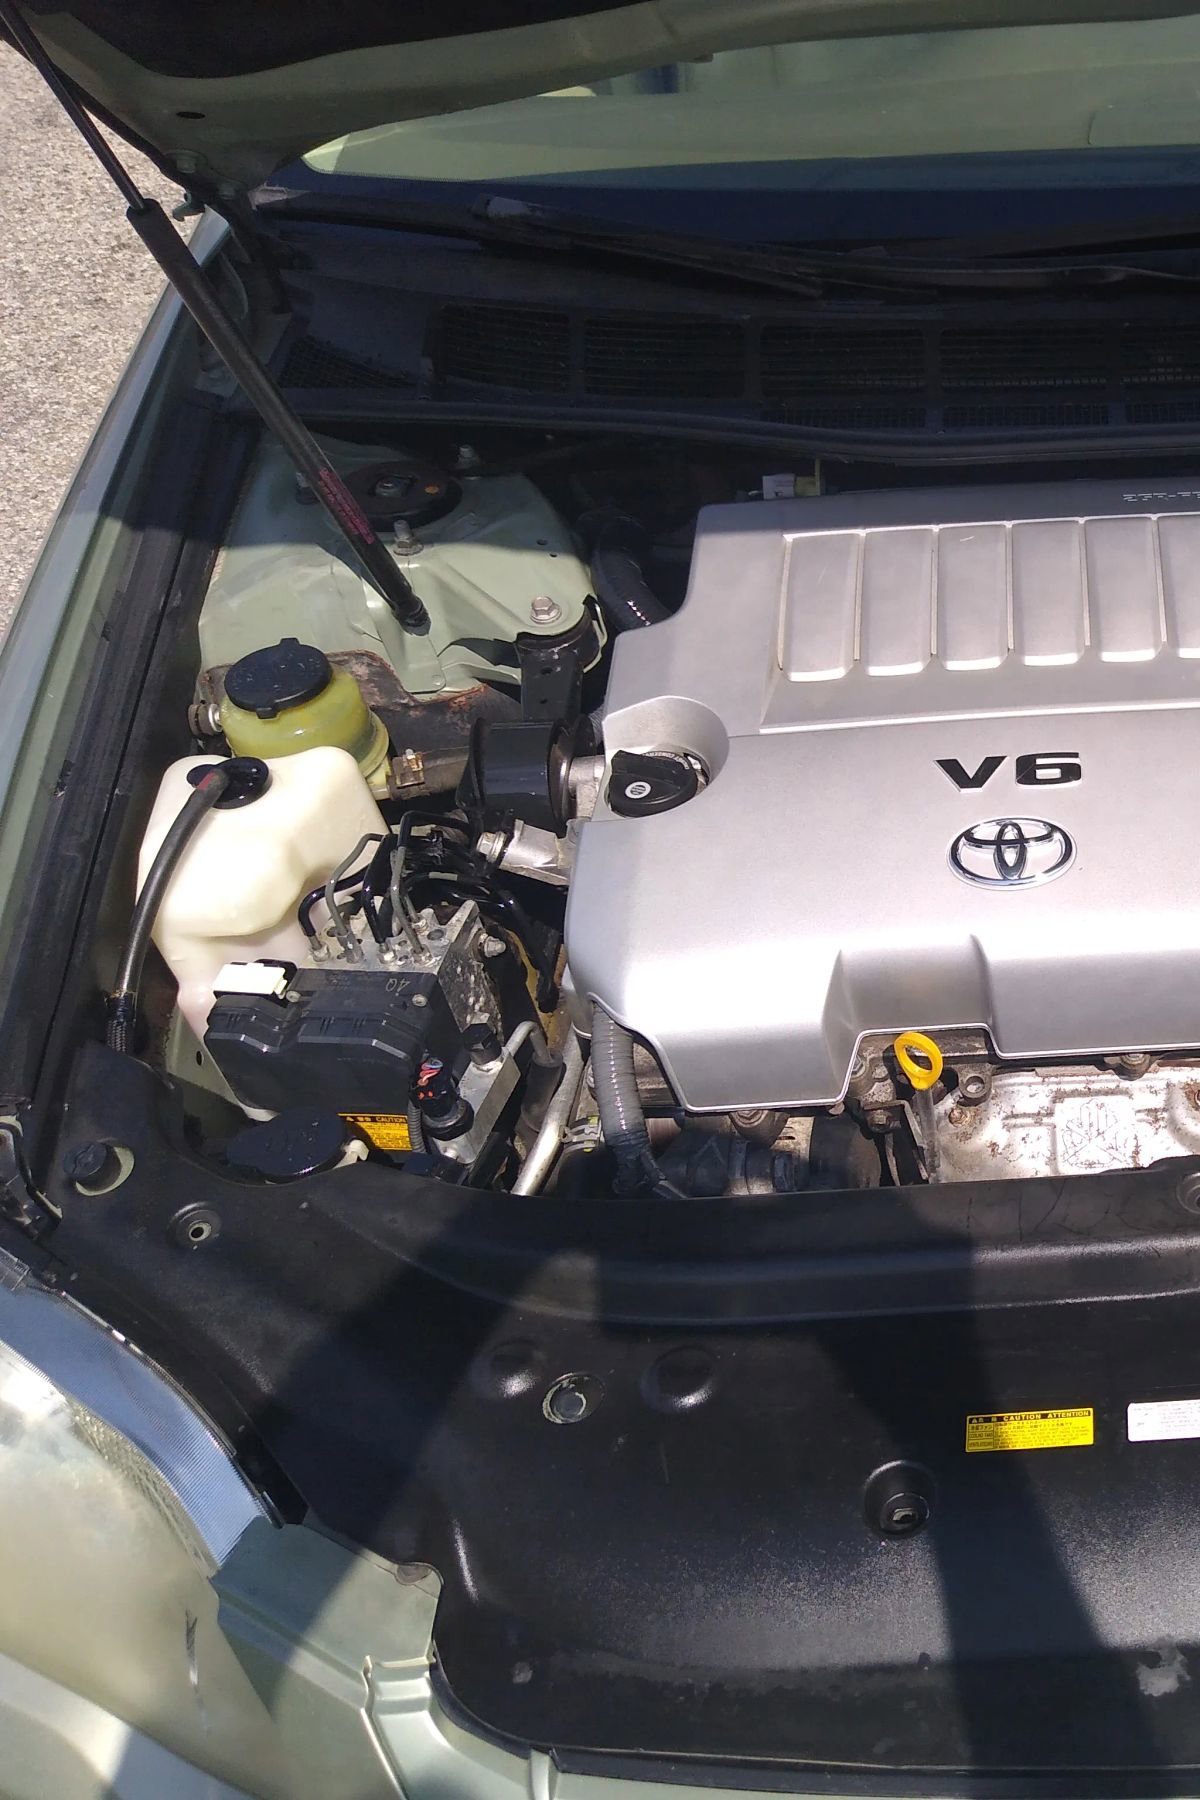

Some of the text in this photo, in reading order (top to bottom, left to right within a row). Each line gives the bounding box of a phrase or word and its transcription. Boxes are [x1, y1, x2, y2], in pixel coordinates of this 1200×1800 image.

[935, 752, 1082, 790] V6
[1003, 1414, 1041, 1422] CAUTION
[1047, 1410, 1089, 1418] ATTENTION
